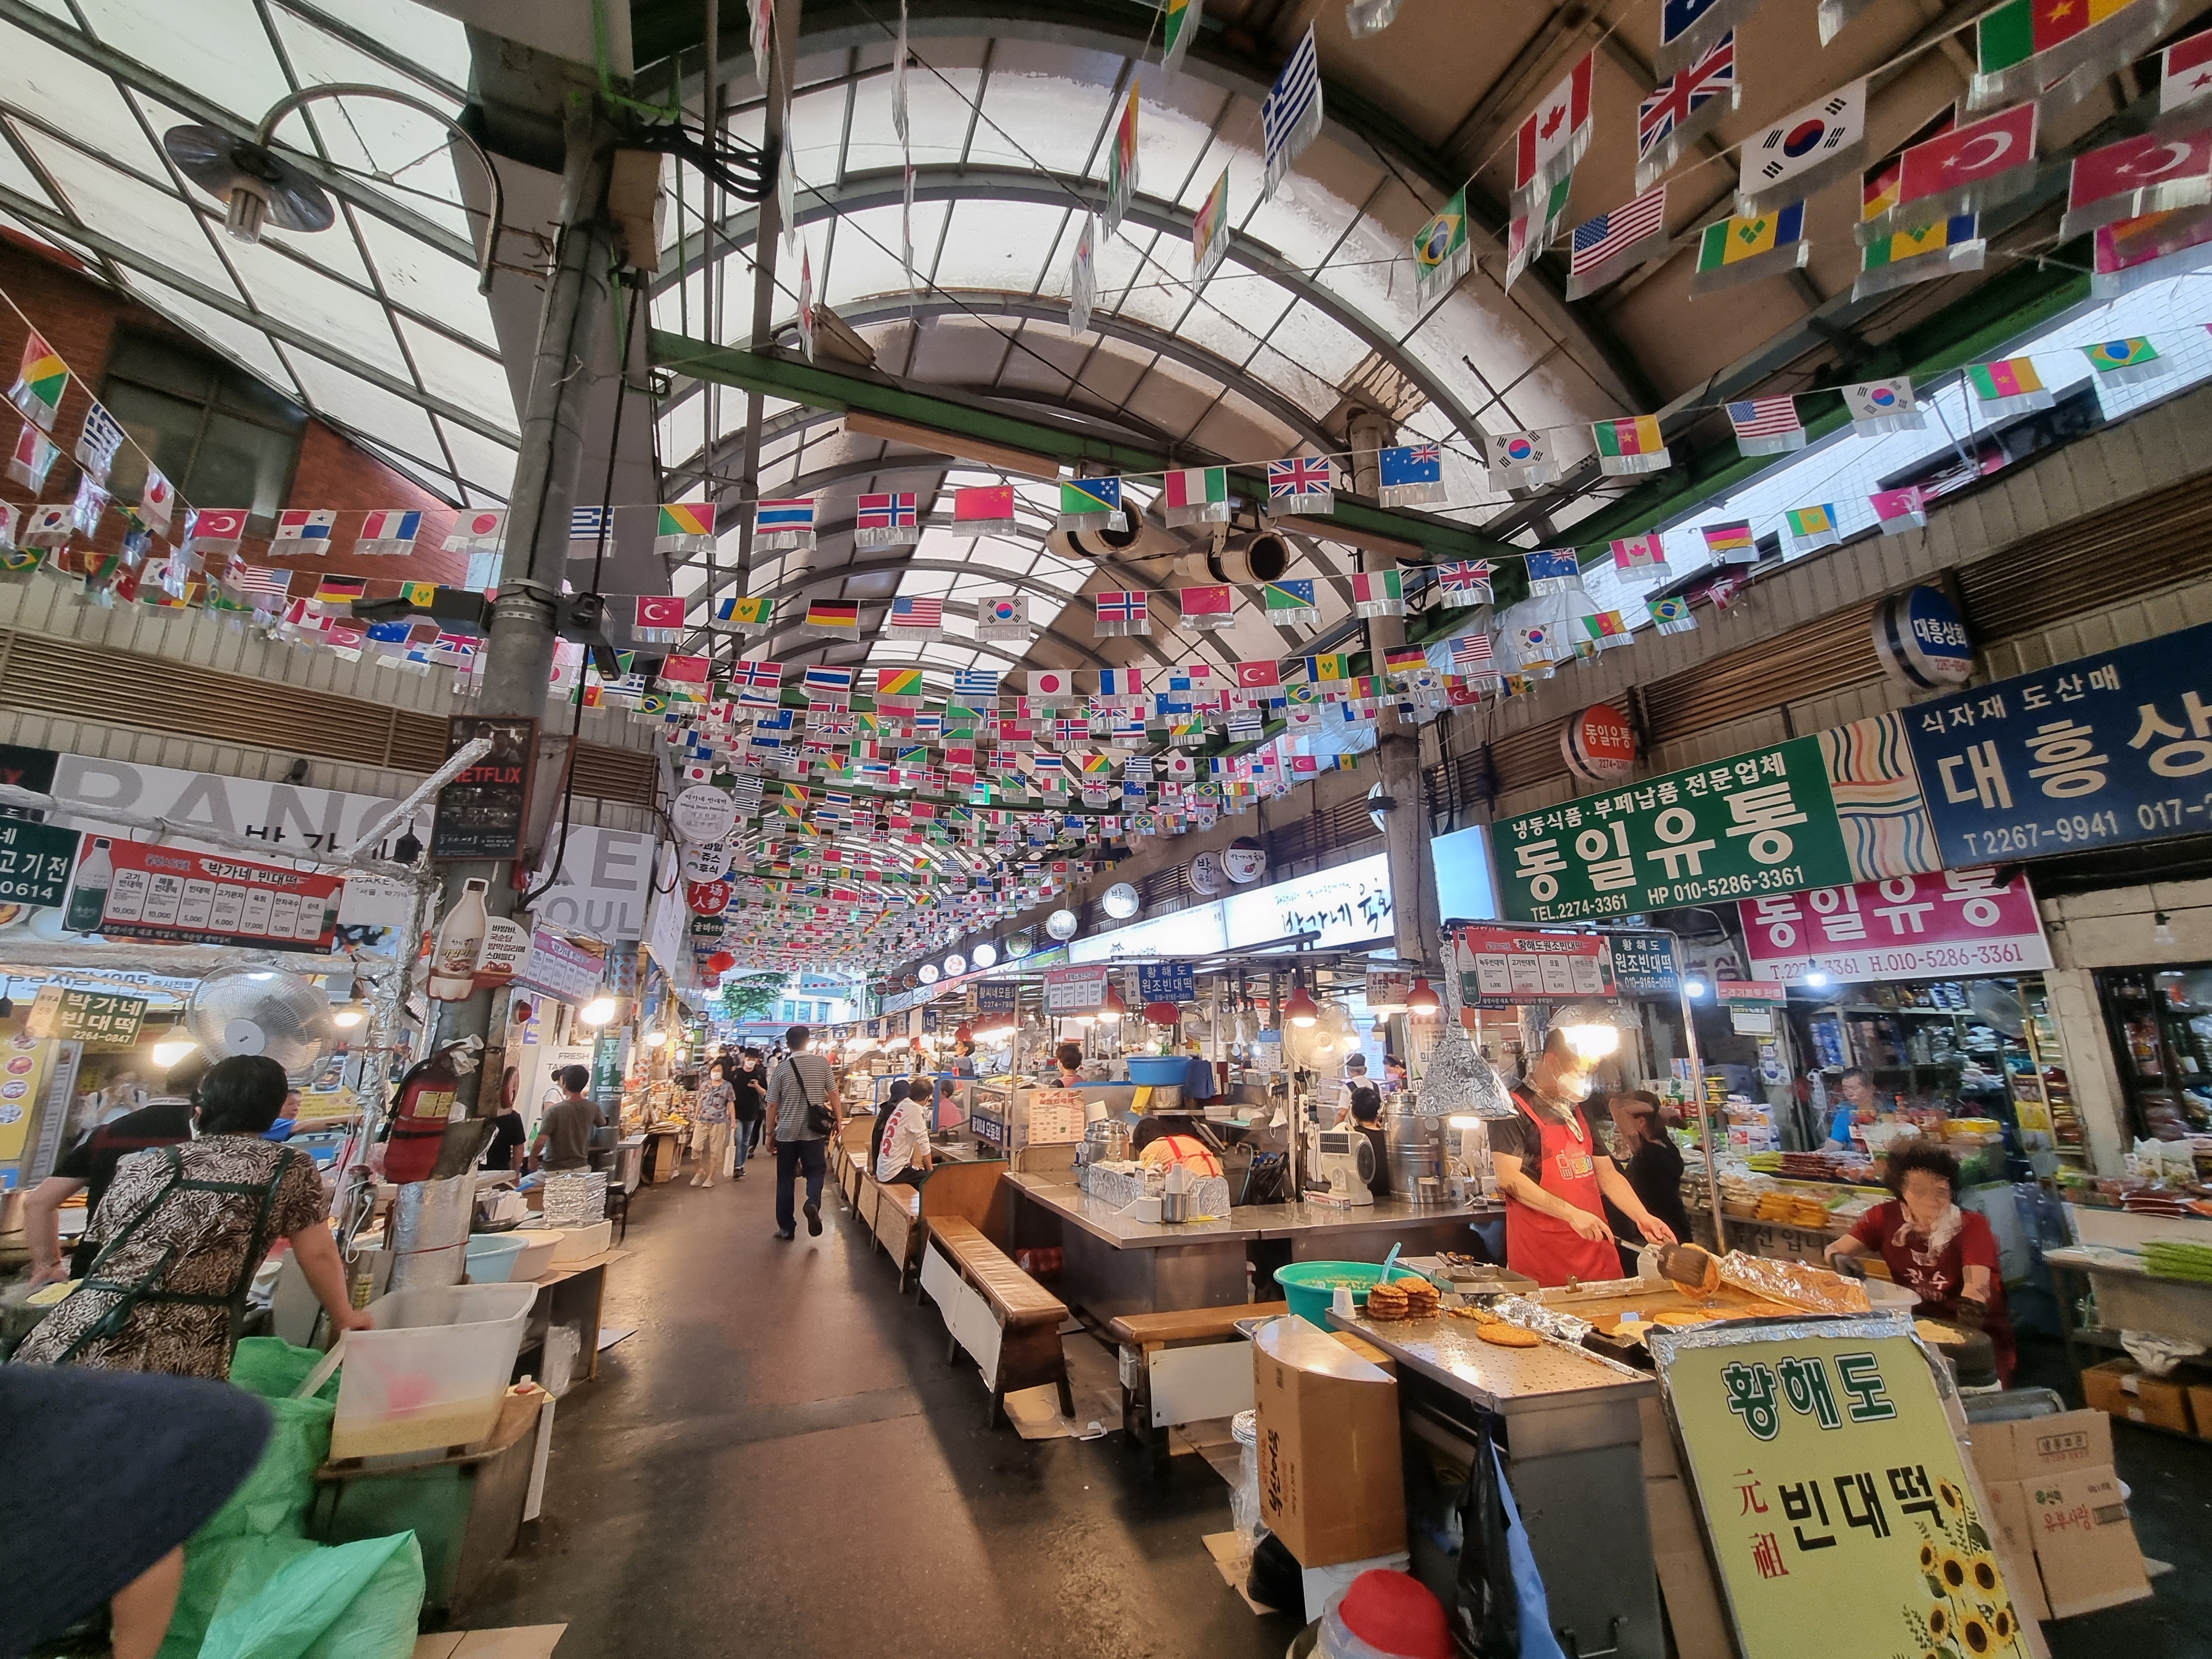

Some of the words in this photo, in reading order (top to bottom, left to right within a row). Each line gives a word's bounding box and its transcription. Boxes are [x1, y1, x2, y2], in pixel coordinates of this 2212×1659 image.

[1921, 694, 2007, 734] 식자재
[2023, 664, 2121, 710] 도산매
[1585, 724, 1631, 749] 동일유통
[1685, 752, 1787, 798] 전문업체
[1983, 810, 2119, 855] 2267-9941
[1514, 782, 1808, 901] 동일유통
[701, 852, 721, 863] 쥬스
[208, 862, 252, 881] 박가네
[258, 871, 298, 887] 빈대떡
[698, 864, 719, 875] 후식
[125, 872, 140, 882] 고기
[189, 885, 211, 895] 빈대떡
[695, 884, 724, 896] 广场
[1531, 894, 1628, 922] TEL.2274-3361
[1647, 885, 1668, 905] HP
[1674, 866, 1805, 903] 010-5286-3361
[275, 898, 300, 907] 잔치국수
[692, 896, 721, 909] 人参
[112, 906, 137, 916] 10,000
[148, 911, 171, 919] 10,000
[184, 915, 203, 923] 5,000
[492, 924, 517, 934] 바밤바,
[490, 933, 513, 943] 국순당
[1622, 938, 1661, 951] 황해도
[1615, 952, 1673, 974] 원조빈대떡
[1770, 957, 1860, 980] T.227-3361
[1869, 944, 2024, 973] H.010-5286-3361
[1147, 966, 1187, 978] 황해도
[1142, 977, 1193, 994] 원조빈대떡
[66, 992, 144, 1016] 박가네
[61, 1011, 138, 1034] 빈대떡
[72, 1030, 132, 1043] 2264-0847
[1720, 1351, 1897, 1441] 황해도
[1778, 1465, 1945, 1551] 빈대떡
